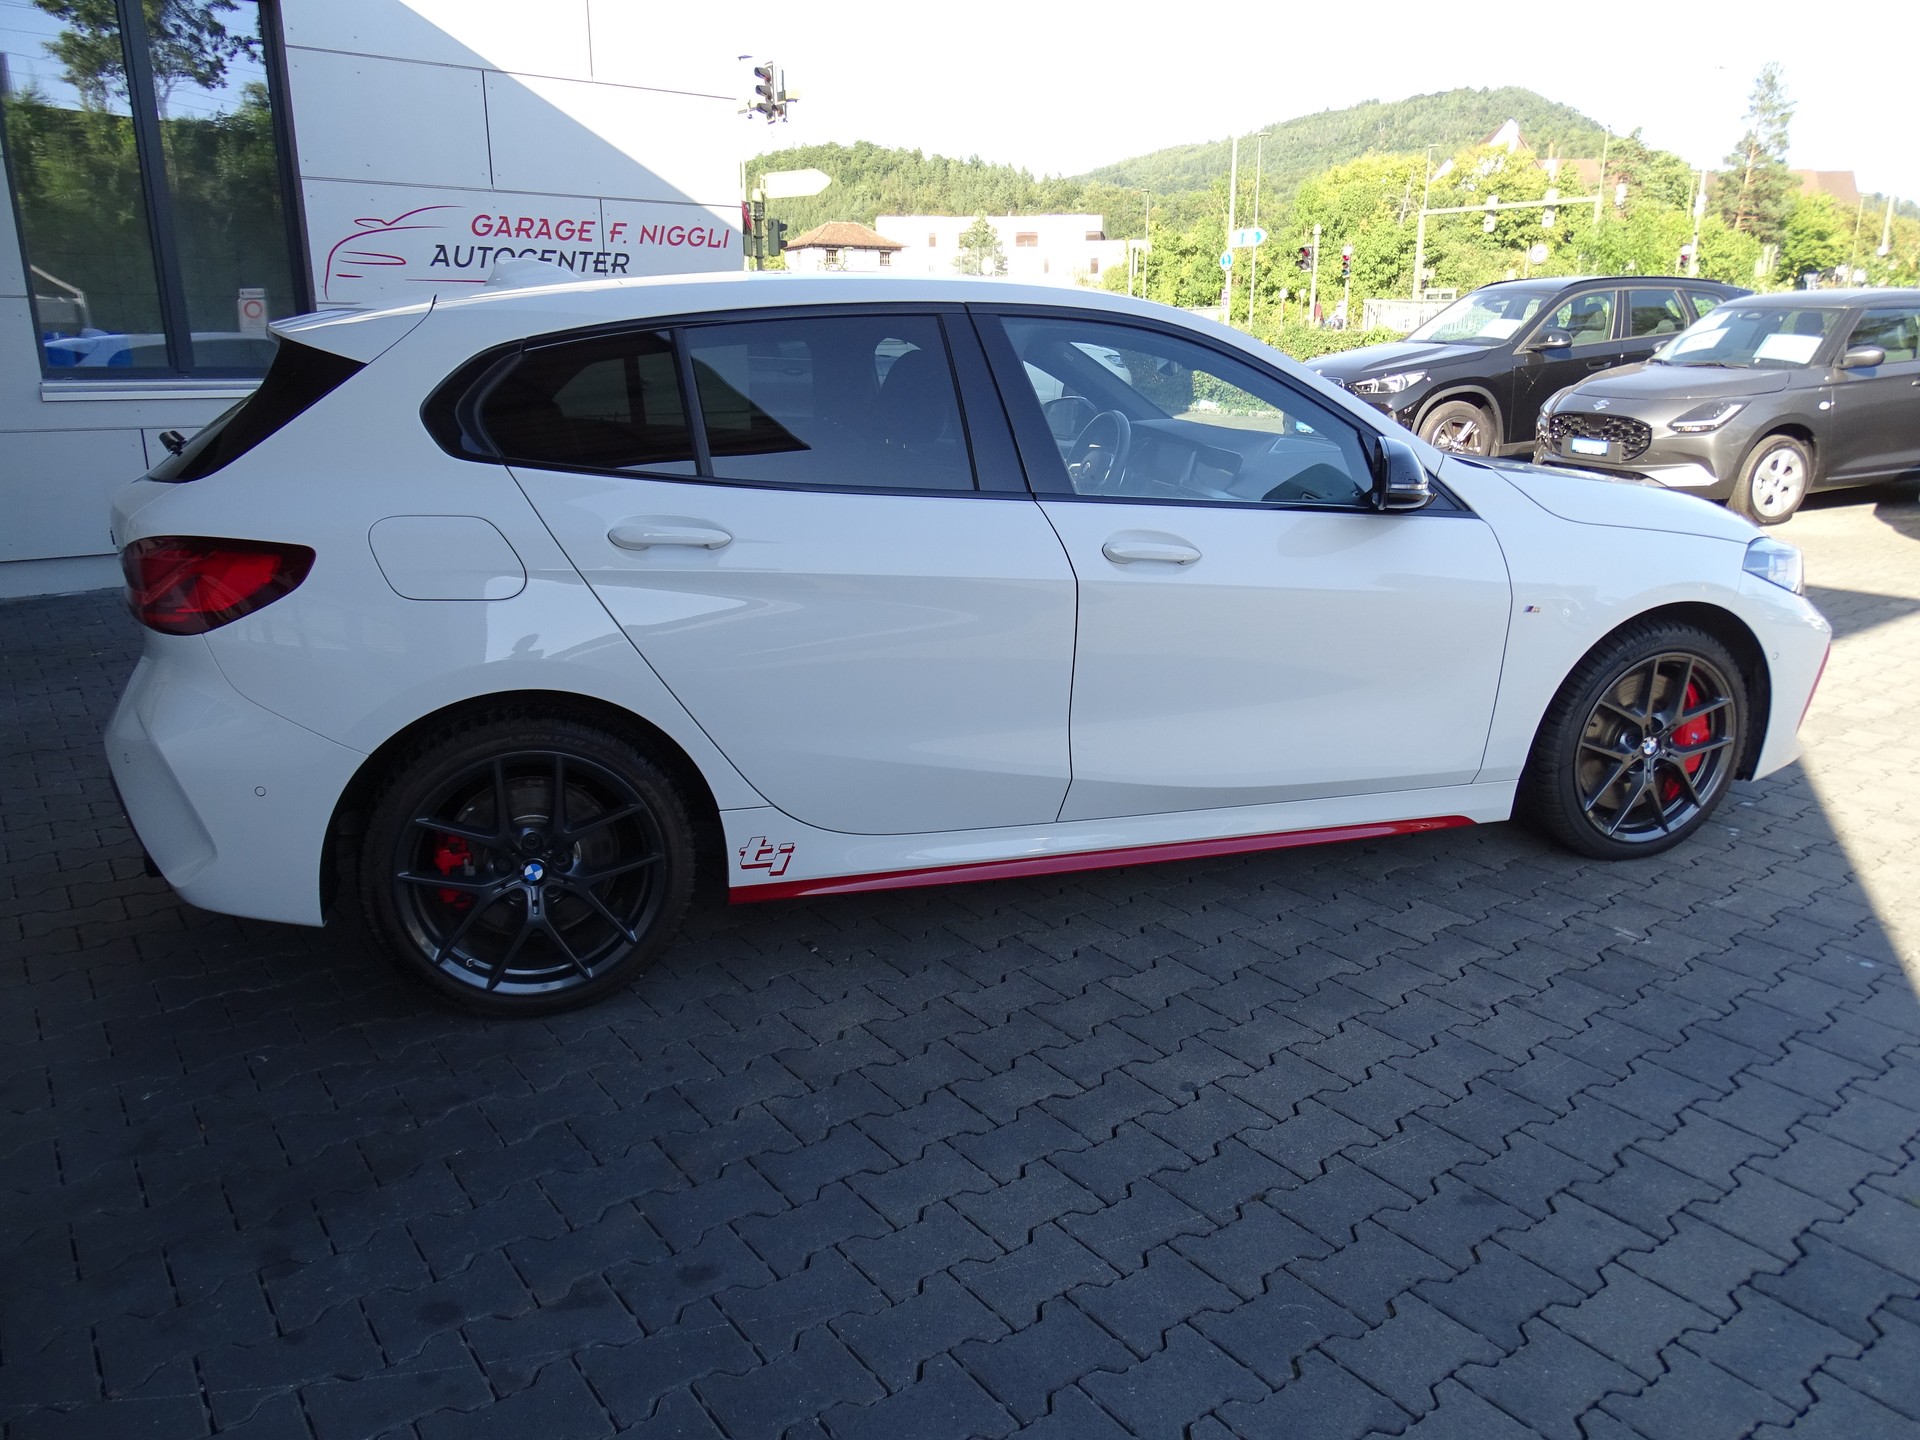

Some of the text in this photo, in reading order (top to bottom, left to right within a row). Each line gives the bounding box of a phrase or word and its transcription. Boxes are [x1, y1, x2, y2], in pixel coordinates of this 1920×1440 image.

[470, 214, 730, 249] GARAGE F. NIGGLI
